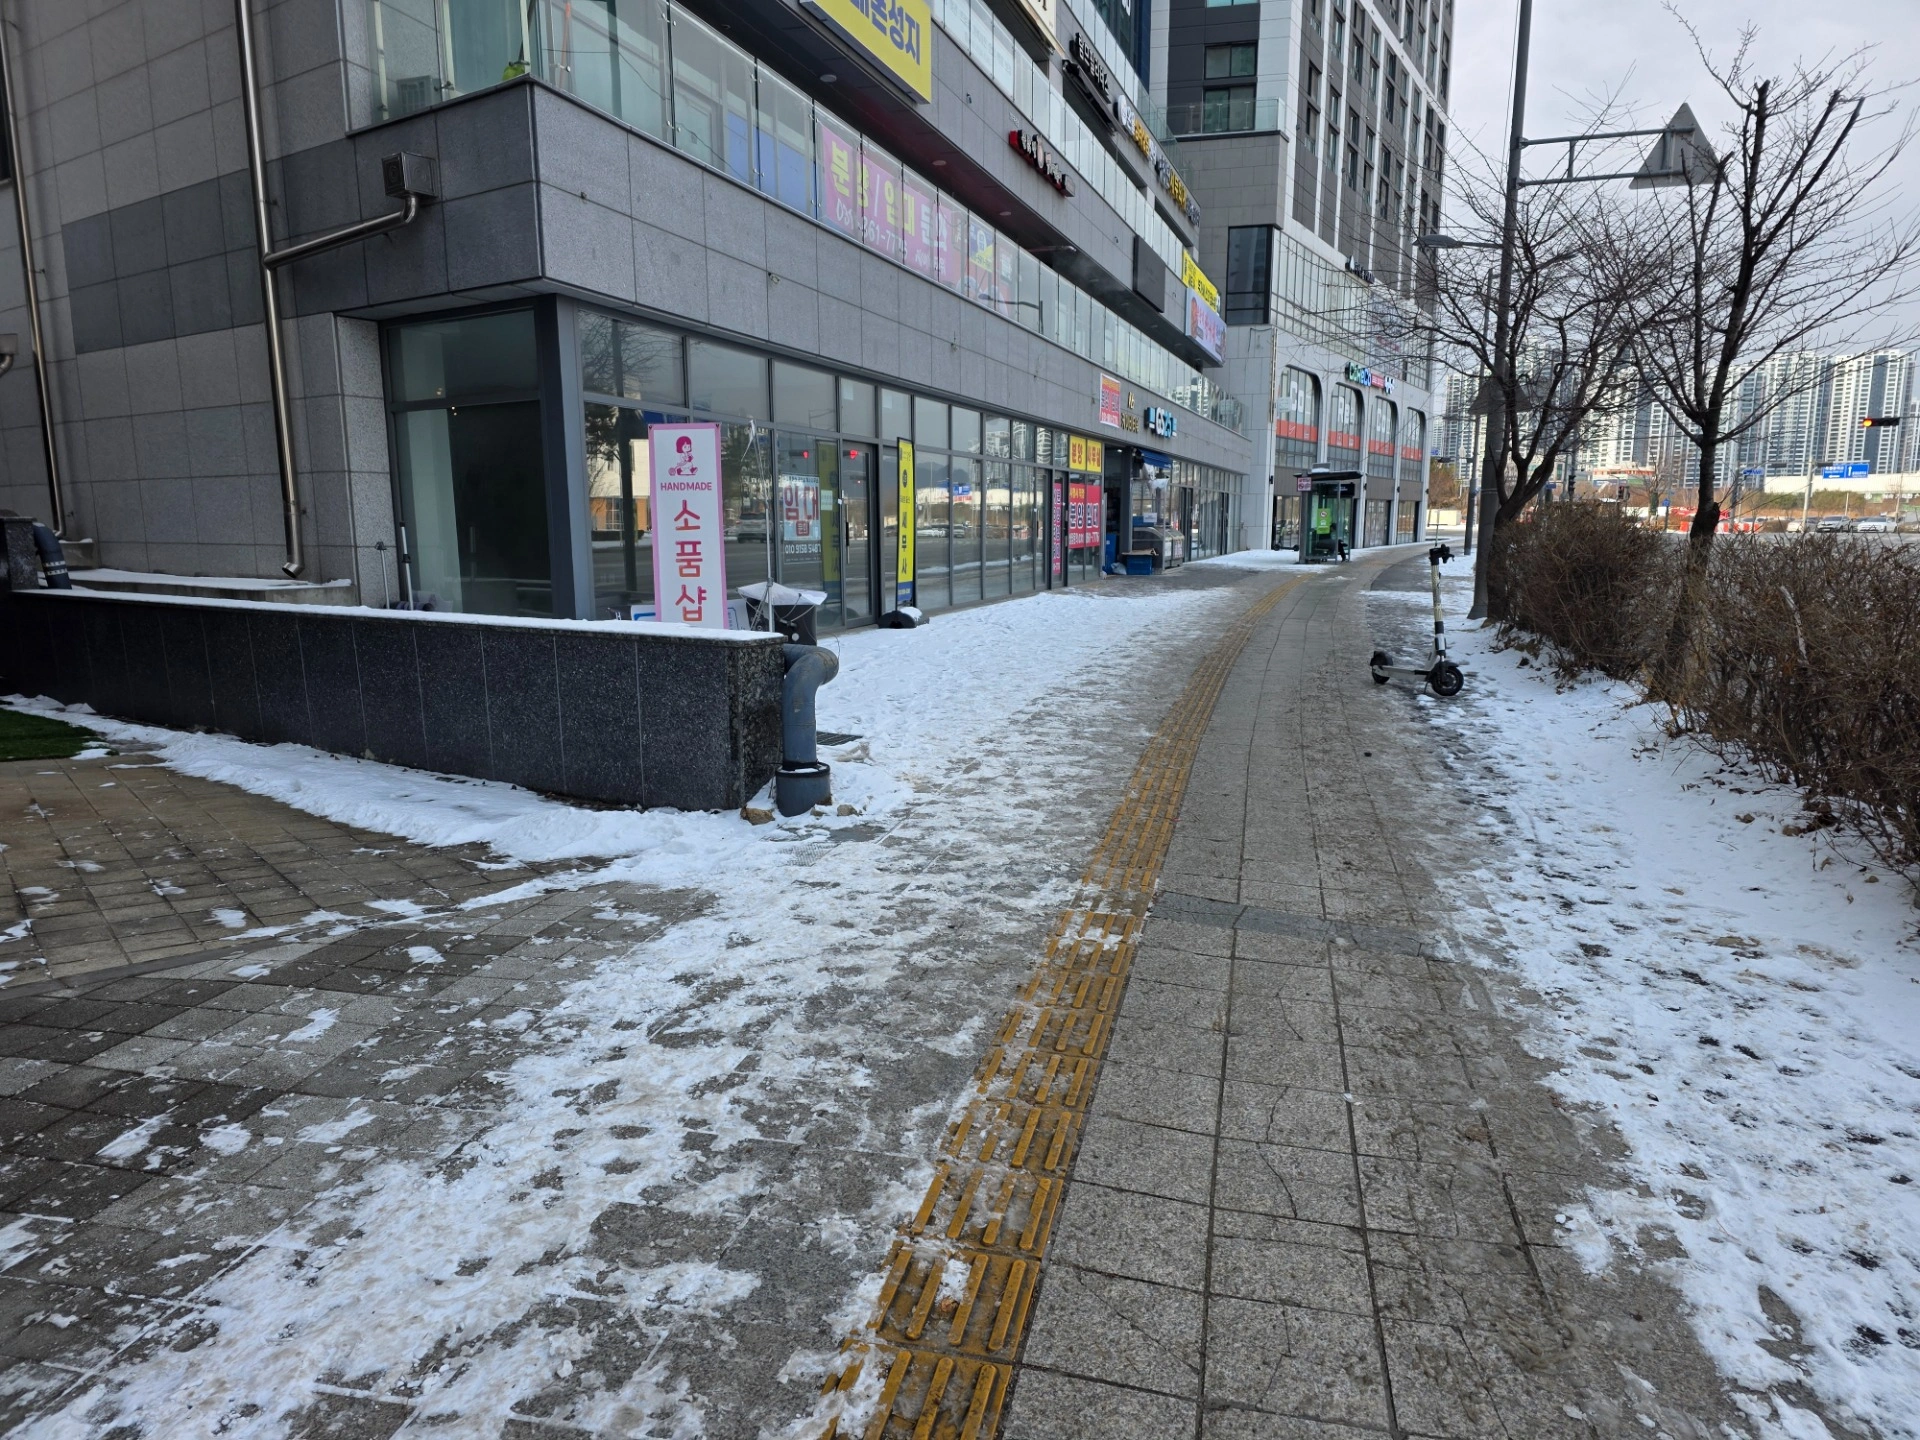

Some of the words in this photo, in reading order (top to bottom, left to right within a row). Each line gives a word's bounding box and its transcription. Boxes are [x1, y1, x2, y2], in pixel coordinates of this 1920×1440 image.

[1156, 407, 1172, 438] GS25
[1071, 443, 1083, 465] 분양
[660, 482, 712, 491] HANDMADE
[784, 485, 819, 520] 임대
[1070, 502, 1084, 529] 분양
[673, 500, 707, 622] 소품샵
